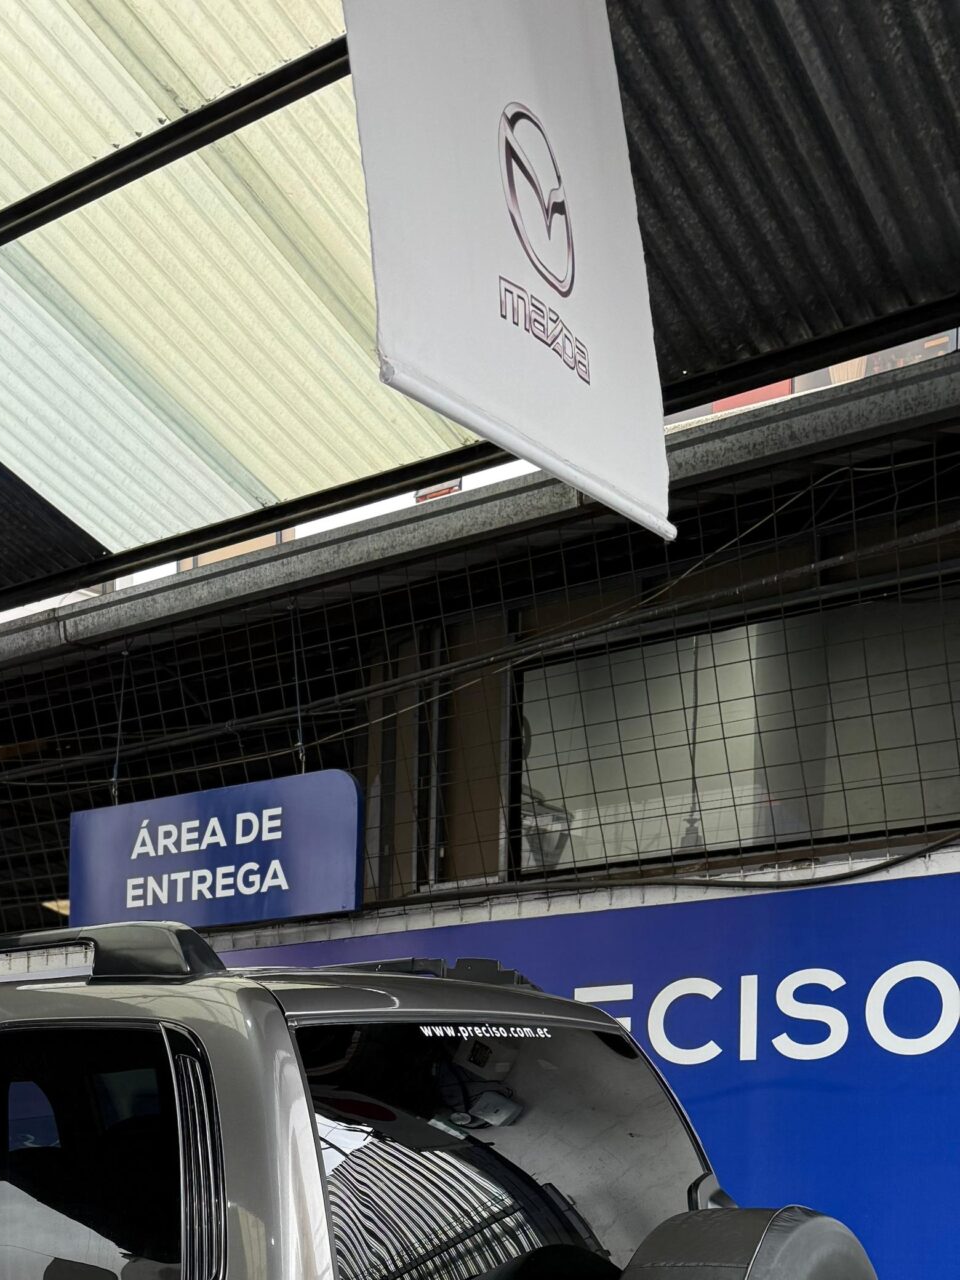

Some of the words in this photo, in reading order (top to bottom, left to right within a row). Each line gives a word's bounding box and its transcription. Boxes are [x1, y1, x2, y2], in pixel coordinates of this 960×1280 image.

[498, 274, 590, 386] mazda
[130, 818, 228, 860] ÁREA
[235, 806, 283, 846] DE
[126, 859, 290, 909] ENTREGA
[419, 1023, 552, 1041] www.preciso.com.ec
